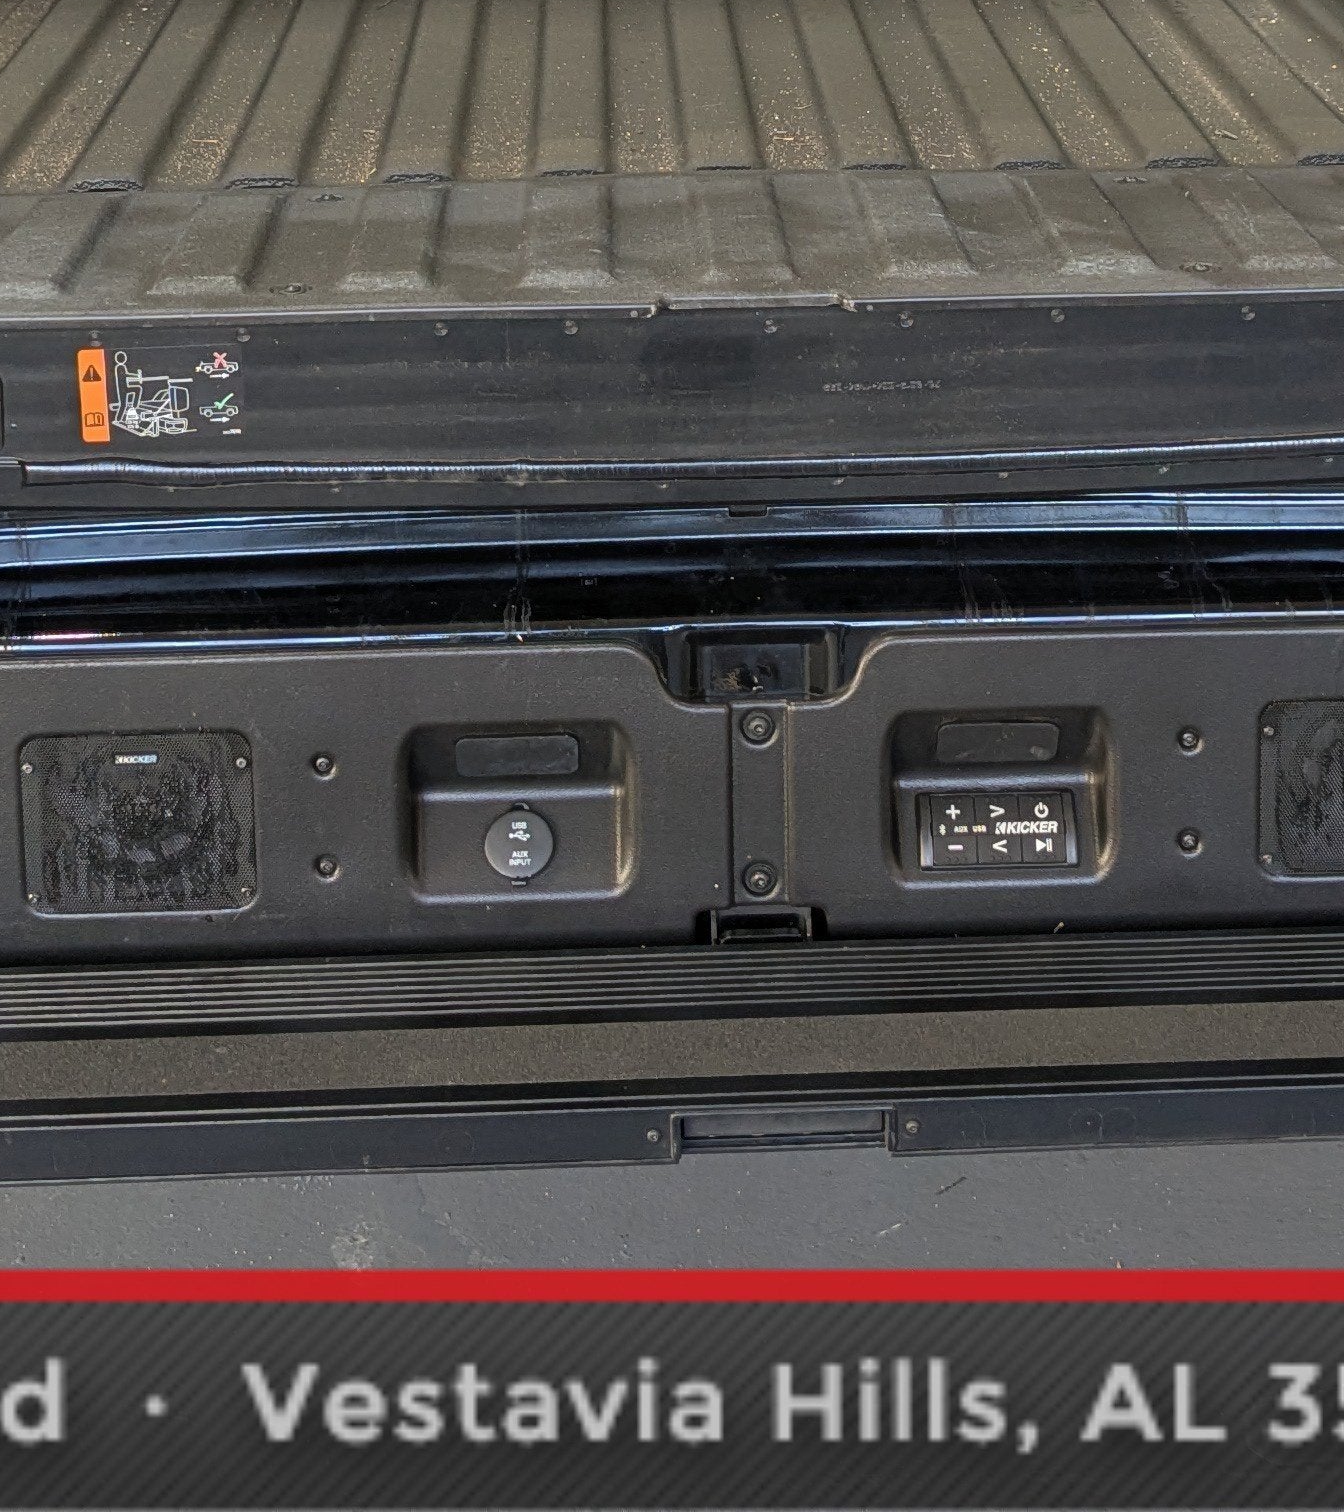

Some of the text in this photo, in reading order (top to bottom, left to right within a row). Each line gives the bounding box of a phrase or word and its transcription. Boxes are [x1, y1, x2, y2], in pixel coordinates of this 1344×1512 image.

[121, 754, 158, 764] KICKER
[511, 821, 528, 830] USB
[1006, 820, 1059, 834] KICKER
[512, 850, 529, 858] AUX
